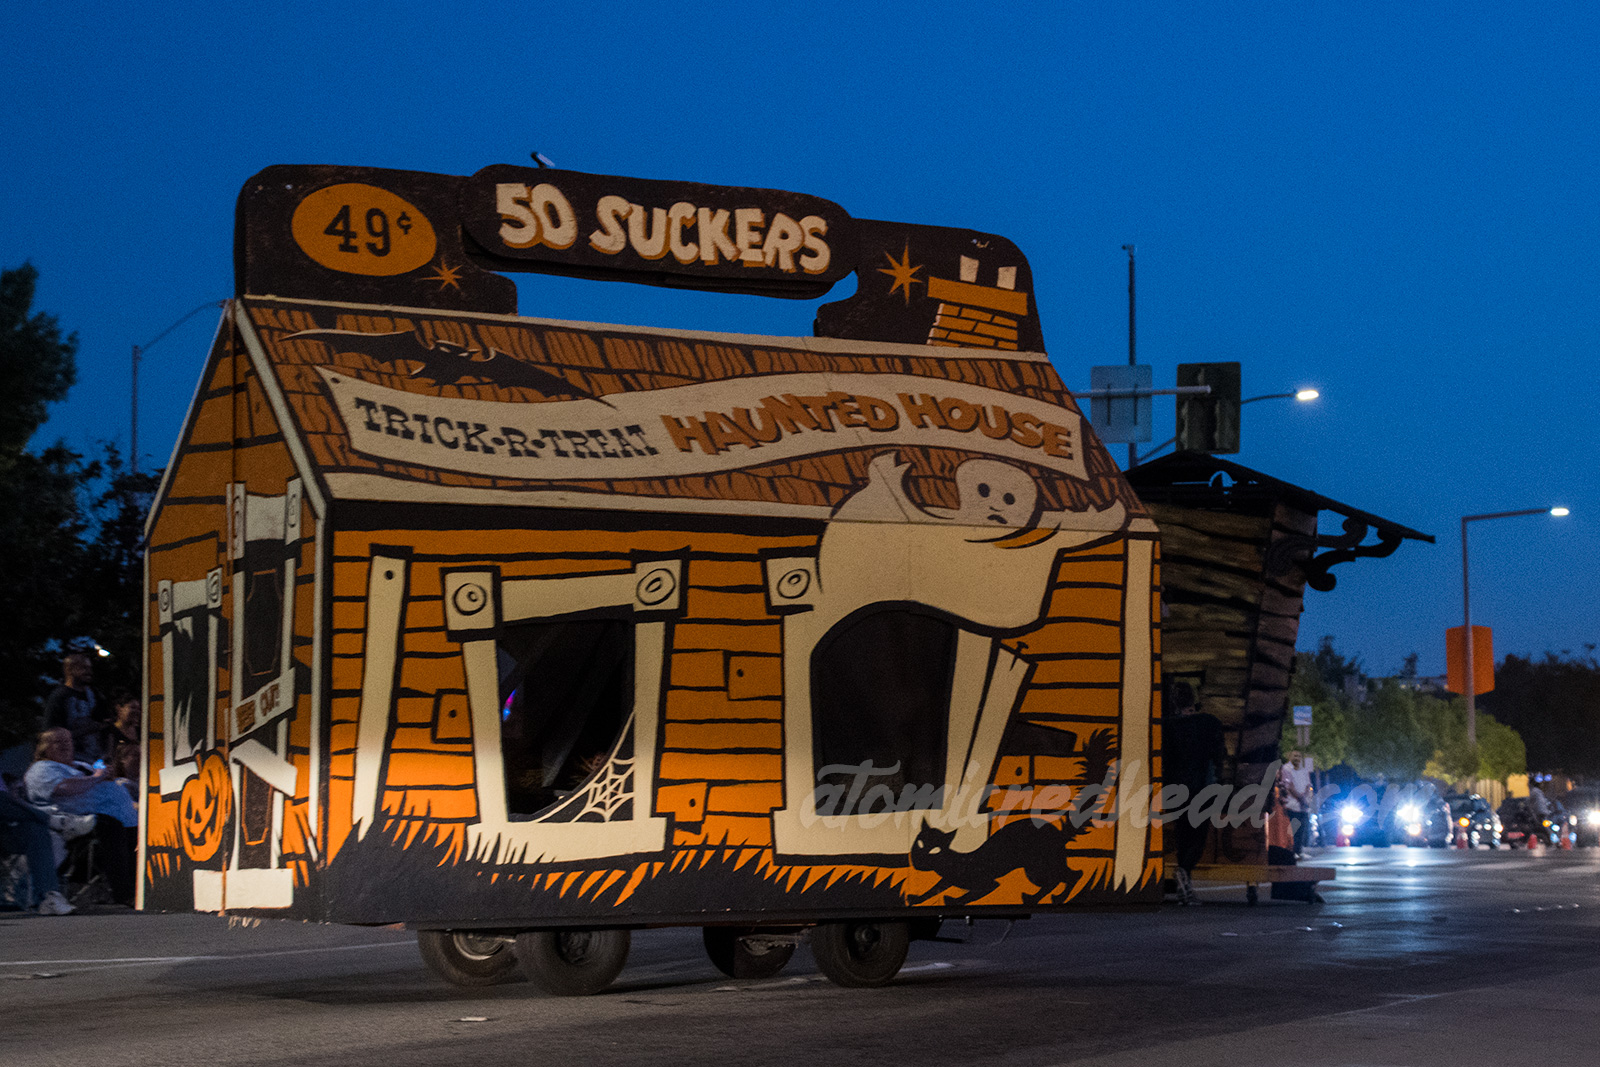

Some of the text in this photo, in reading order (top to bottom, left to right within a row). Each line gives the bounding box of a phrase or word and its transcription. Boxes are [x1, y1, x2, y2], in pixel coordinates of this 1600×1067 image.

[495, 183, 832, 275] 50 SUCKERS
[659, 391, 902, 456] HAUNTED
[897, 392, 1074, 460] HOUSE
